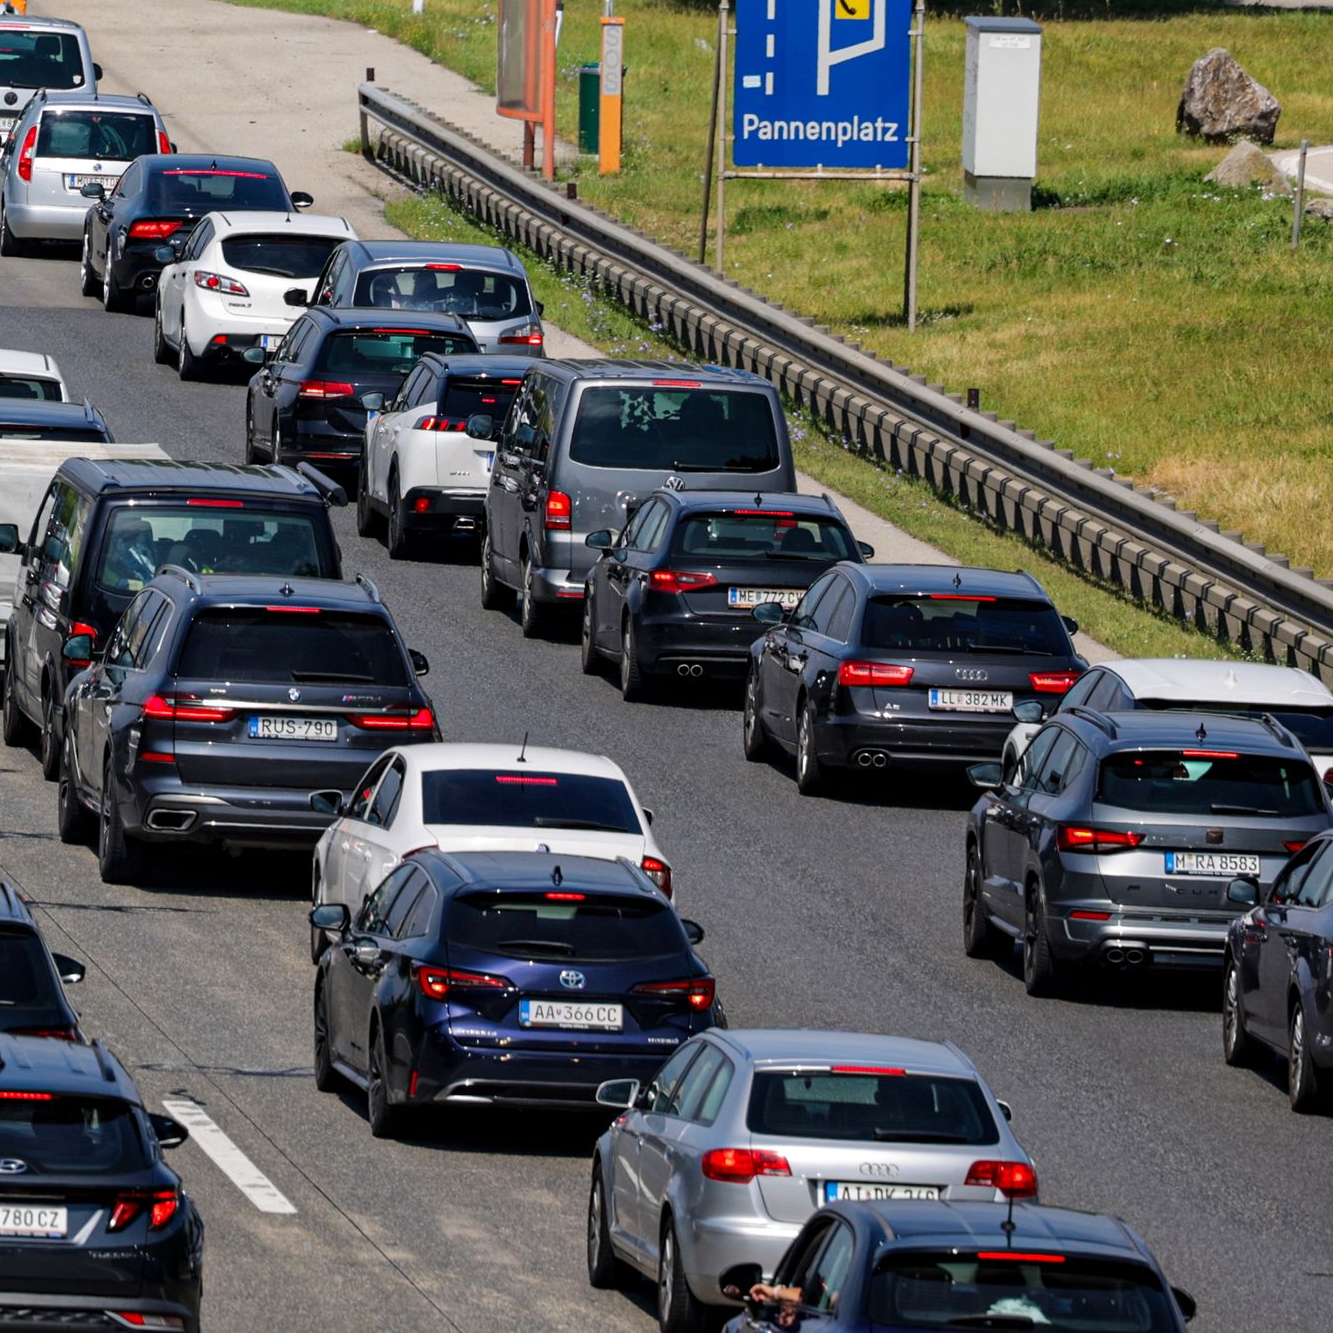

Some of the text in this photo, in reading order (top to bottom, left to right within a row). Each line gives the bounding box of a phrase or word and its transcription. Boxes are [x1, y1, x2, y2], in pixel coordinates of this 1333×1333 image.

[604, 27, 620, 92] SOS
[743, 114, 899, 147] Pannenplatz
[738, 590, 753, 603] ME
[941, 692, 1007, 706] LL 382 MK
[261, 718, 334, 736] RUS-790
[1176, 856, 1258, 872] M RA 8583
[534, 1006, 617, 1023] AA 366 CC
[1, 1209, 34, 1227] 780
[37, 1211, 60, 1228] CZ
